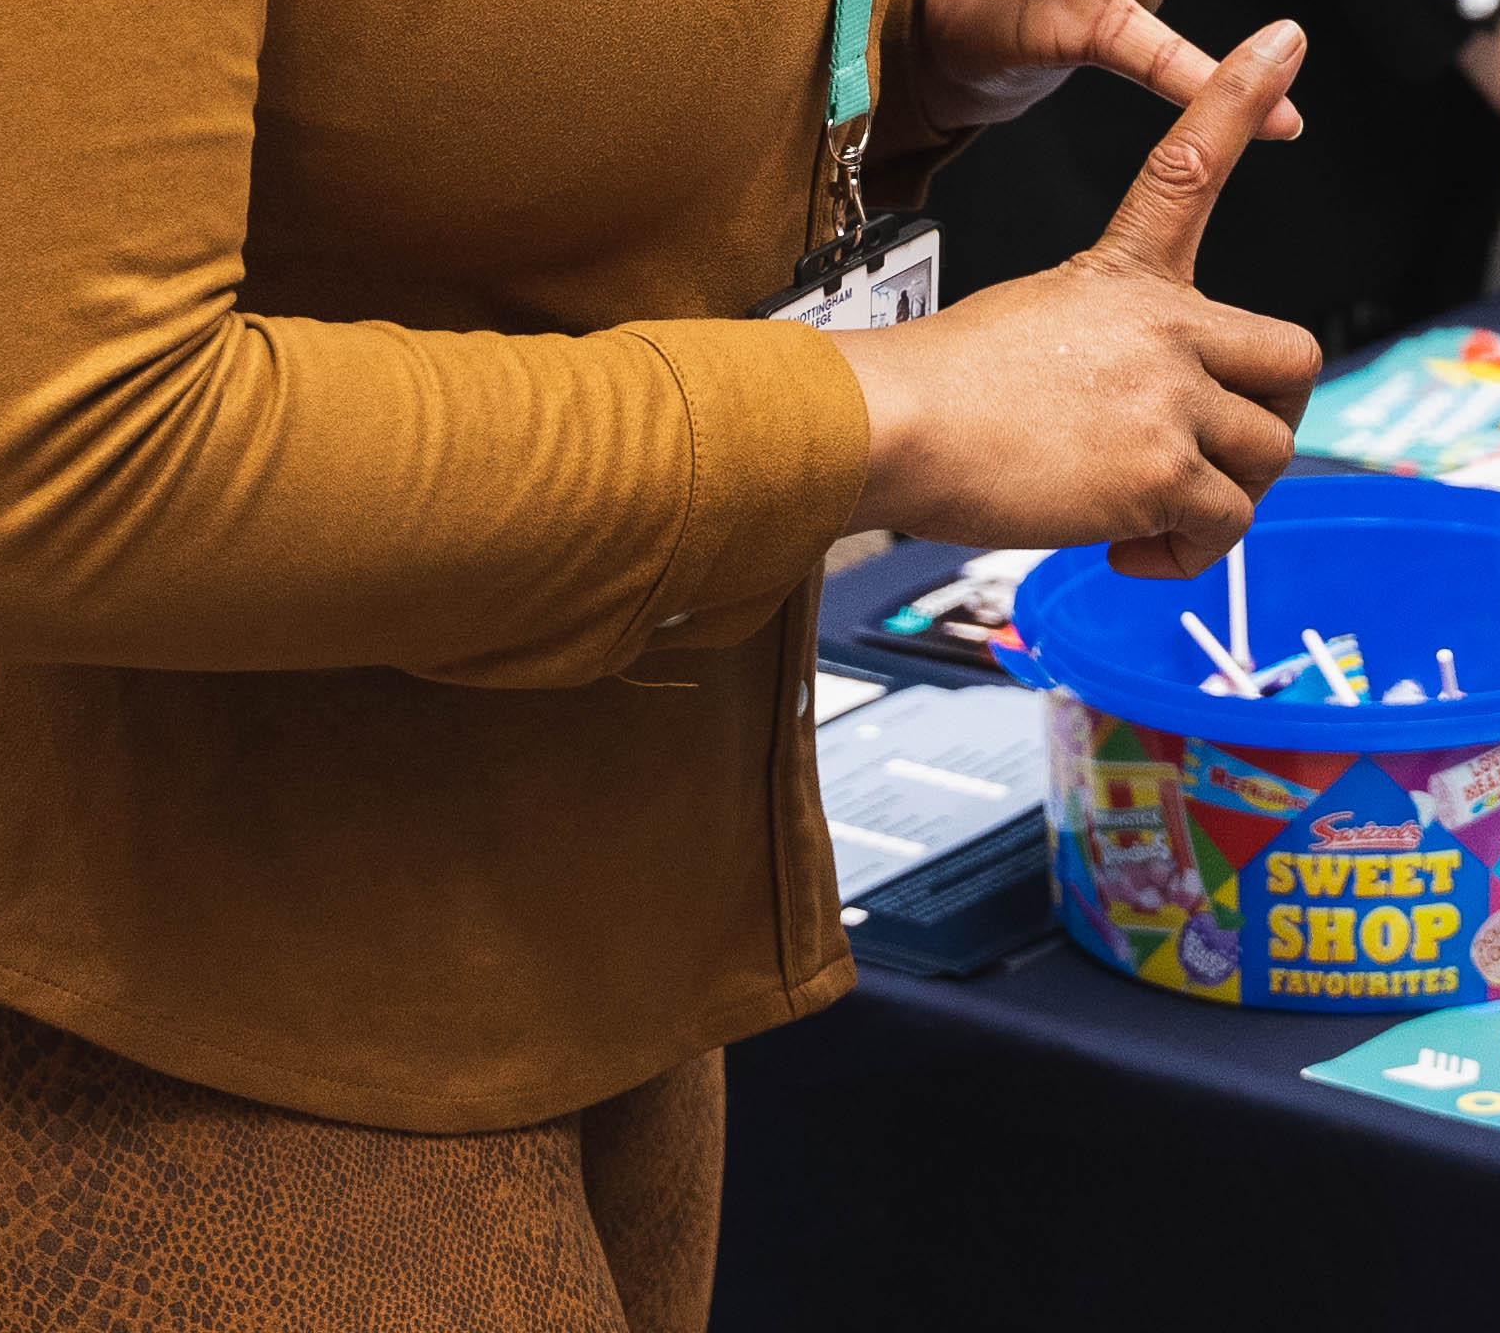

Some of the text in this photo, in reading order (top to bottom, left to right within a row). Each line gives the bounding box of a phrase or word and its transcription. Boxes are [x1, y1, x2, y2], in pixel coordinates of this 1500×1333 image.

[1266, 849, 1462, 898] SWEET
[1268, 903, 1462, 965] SHOP
[1268, 966, 1460, 998] FAVOURITES
